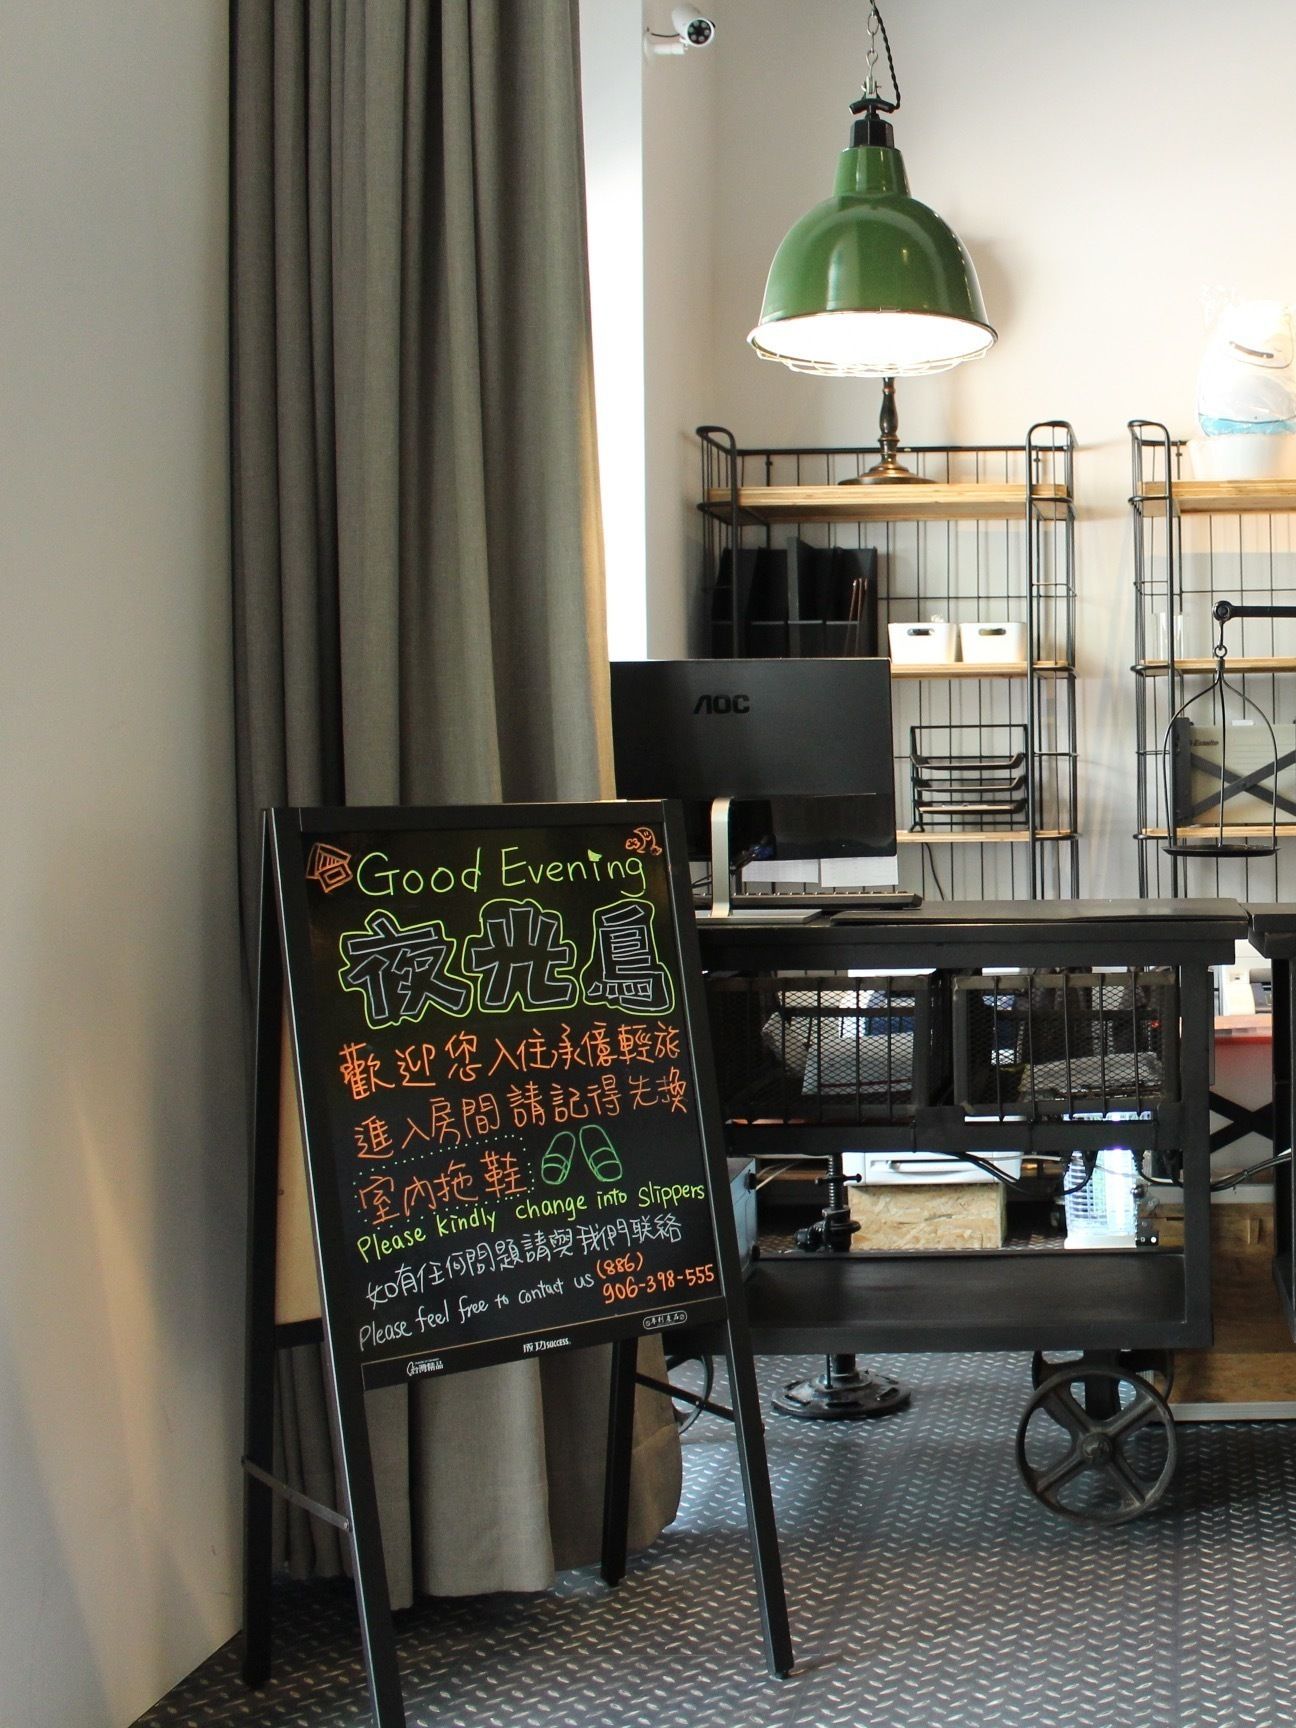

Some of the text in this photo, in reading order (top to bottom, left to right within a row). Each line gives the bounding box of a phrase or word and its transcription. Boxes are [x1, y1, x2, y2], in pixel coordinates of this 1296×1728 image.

[693, 694, 750, 715] AOC
[356, 846, 647, 898] Good Evening
[356, 1227, 427, 1263] Please
[435, 1207, 497, 1239] kindly
[515, 1196, 588, 1222] change
[597, 1188, 627, 1209] into
[596, 1251, 644, 1280] (886)
[602, 1264, 715, 1305] 906-398-555
[358, 1273, 595, 1352] Please feel free to contact us
